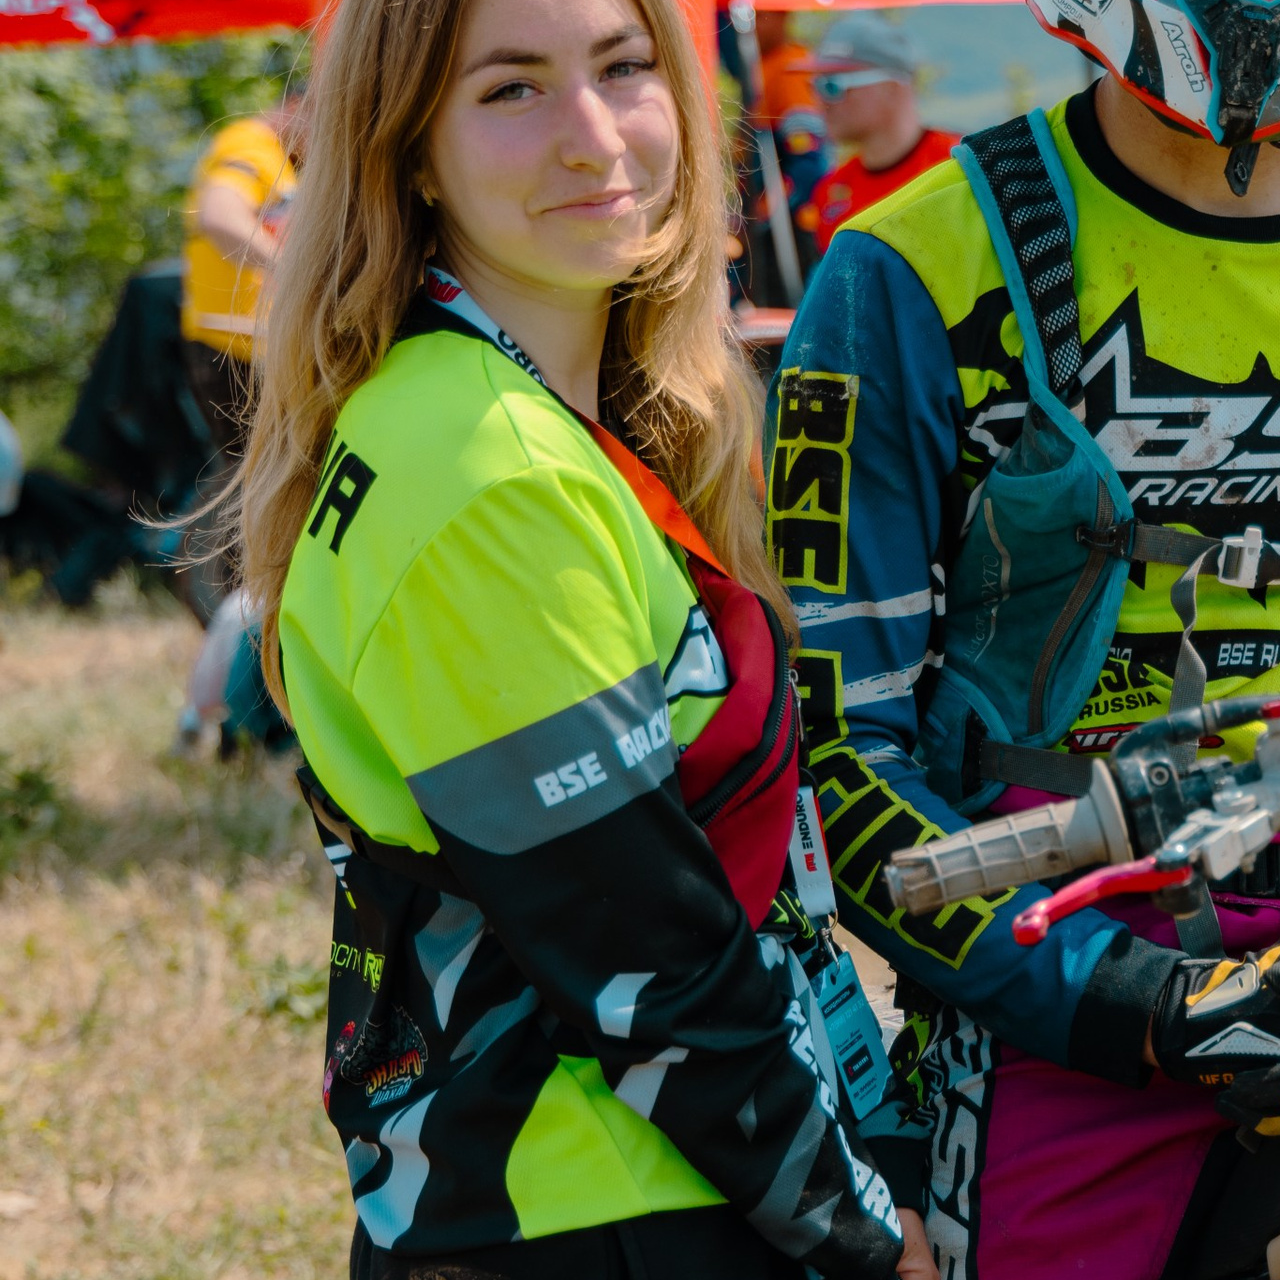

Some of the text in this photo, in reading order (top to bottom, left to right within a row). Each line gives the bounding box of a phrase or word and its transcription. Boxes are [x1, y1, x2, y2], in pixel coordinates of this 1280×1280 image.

[1160, 20, 1208, 94] Airoh
[768, 367, 859, 595] BSE
[1216, 642, 1256, 668] BSE
[1078, 691, 1162, 721] RUSSIA
[534, 752, 608, 808] BSE
